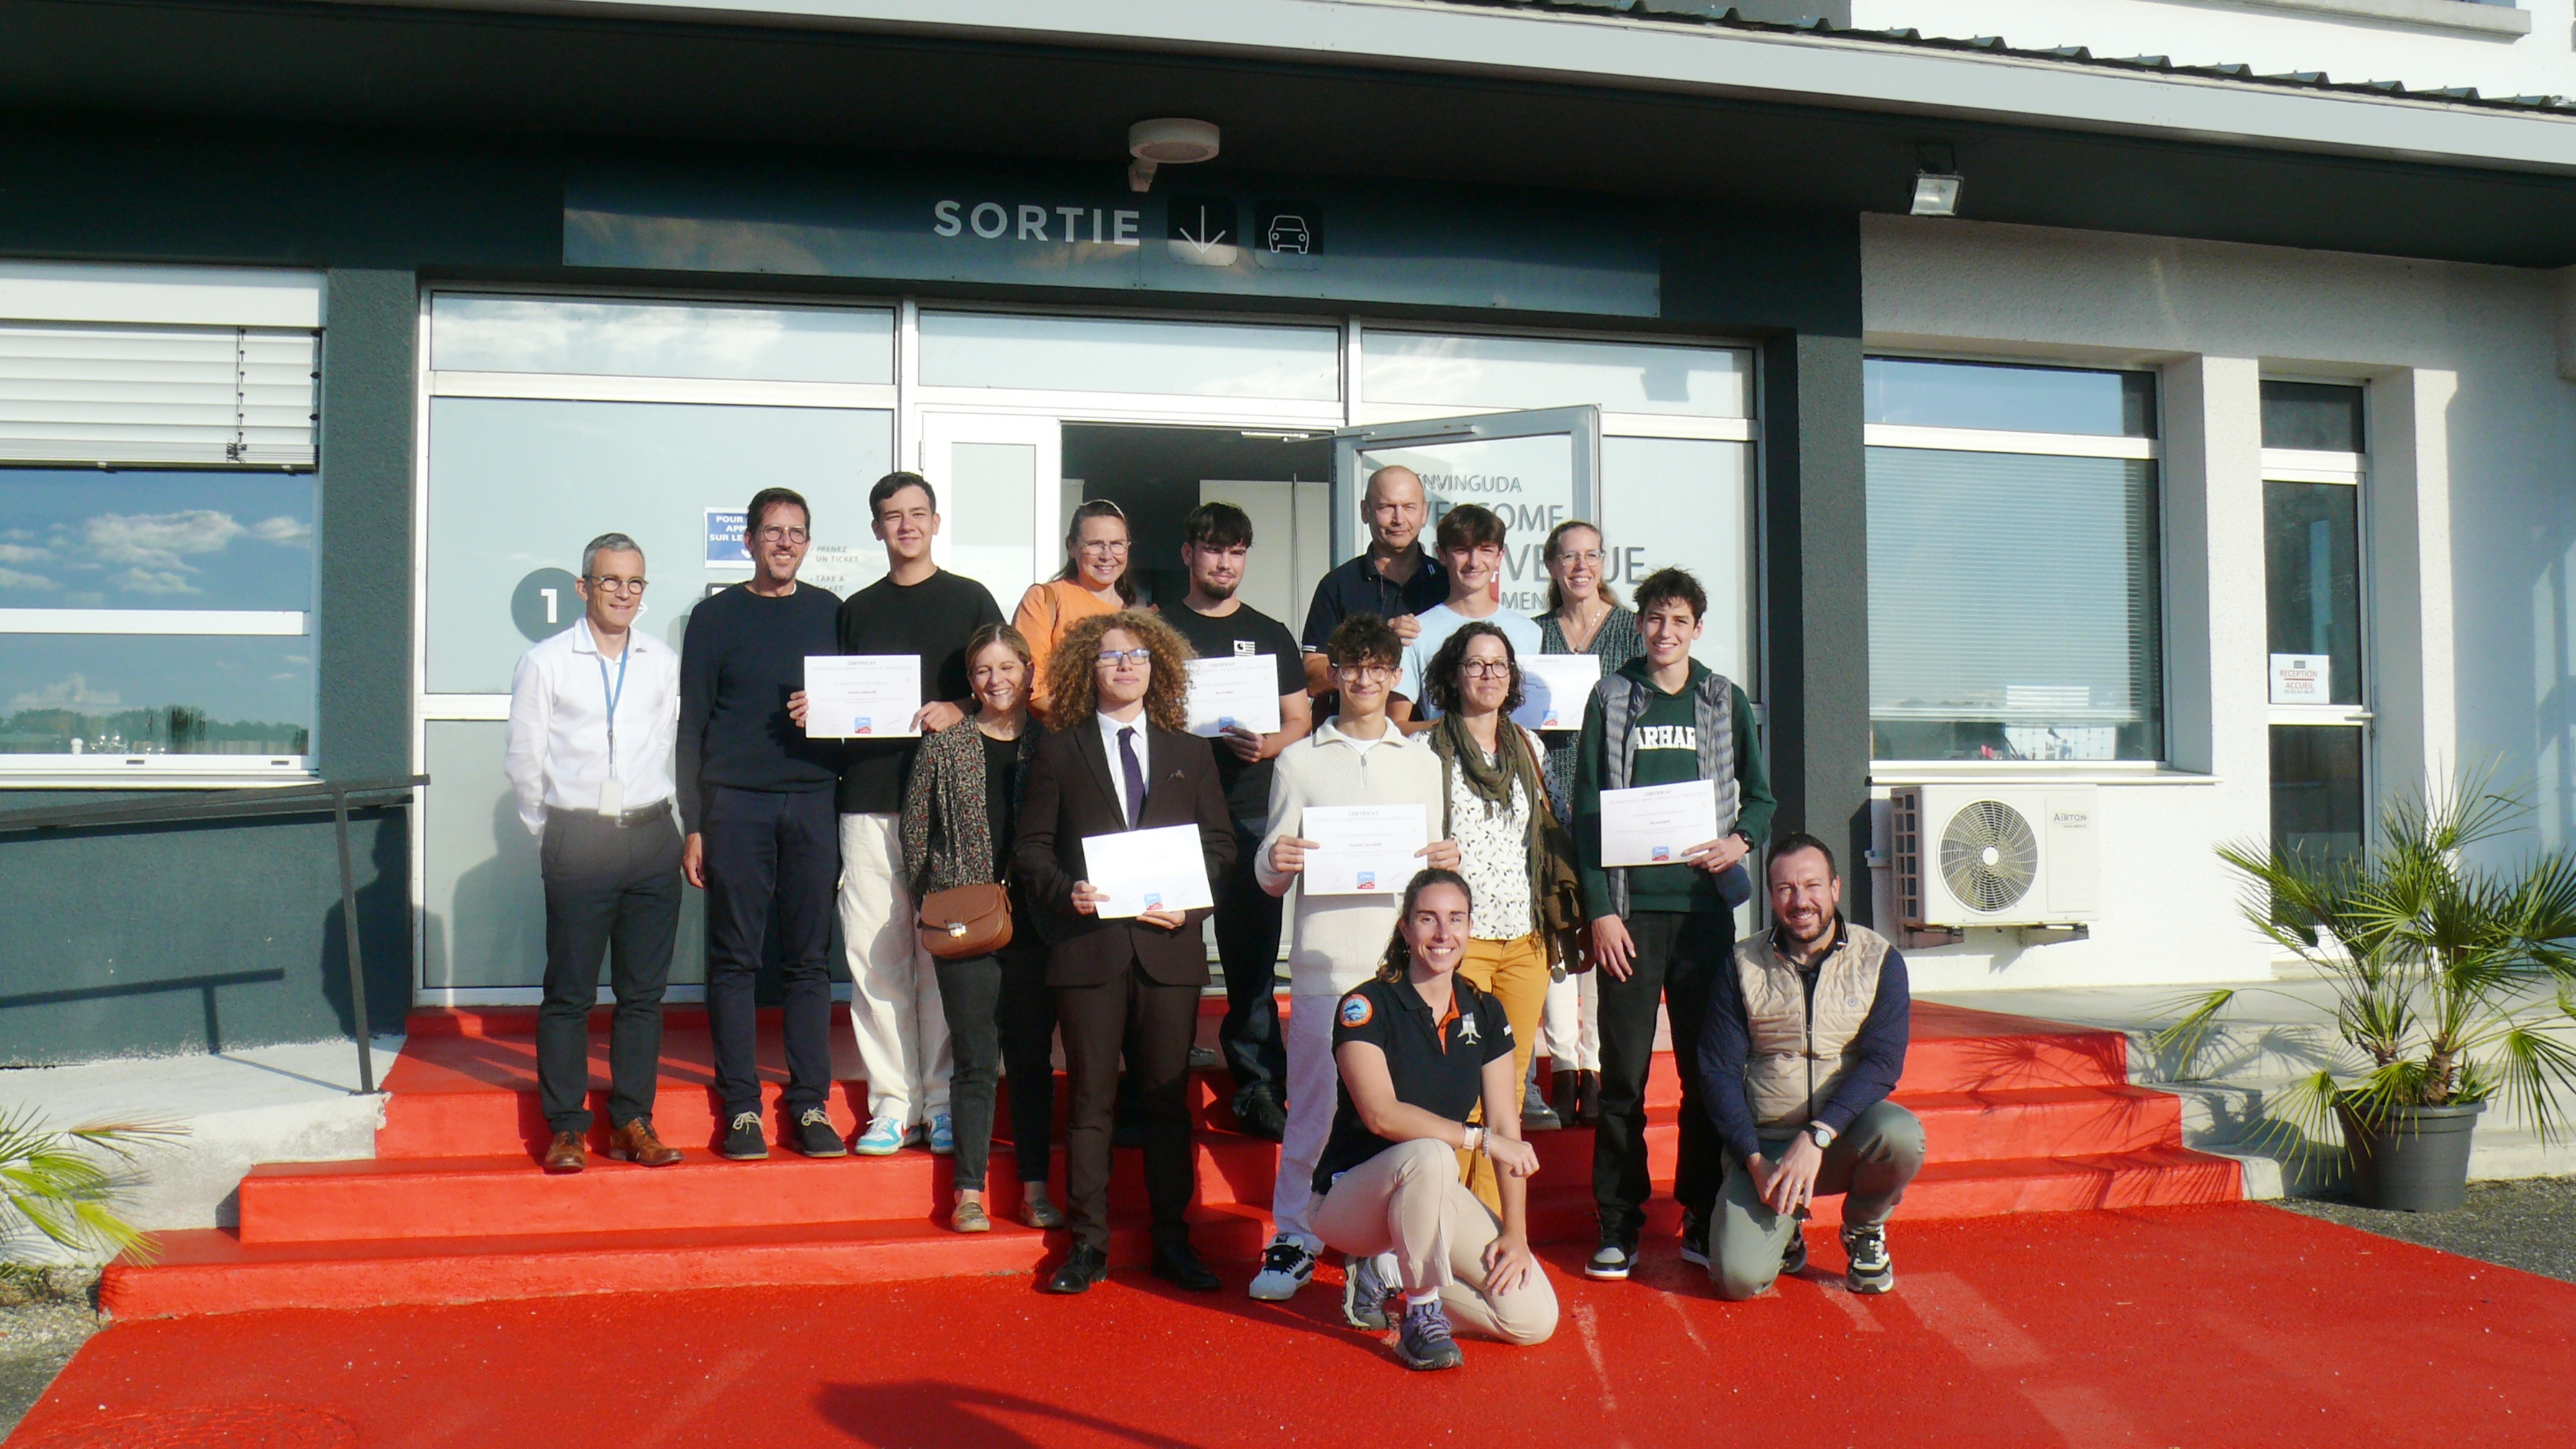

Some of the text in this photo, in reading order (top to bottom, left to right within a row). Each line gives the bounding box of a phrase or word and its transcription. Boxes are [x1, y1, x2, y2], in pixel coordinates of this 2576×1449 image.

[933, 200, 1140, 247] SORTIE
[1418, 473, 1522, 494] NVINGUDA
[716, 515, 743, 523] POUR
[540, 588, 557, 623] 1
